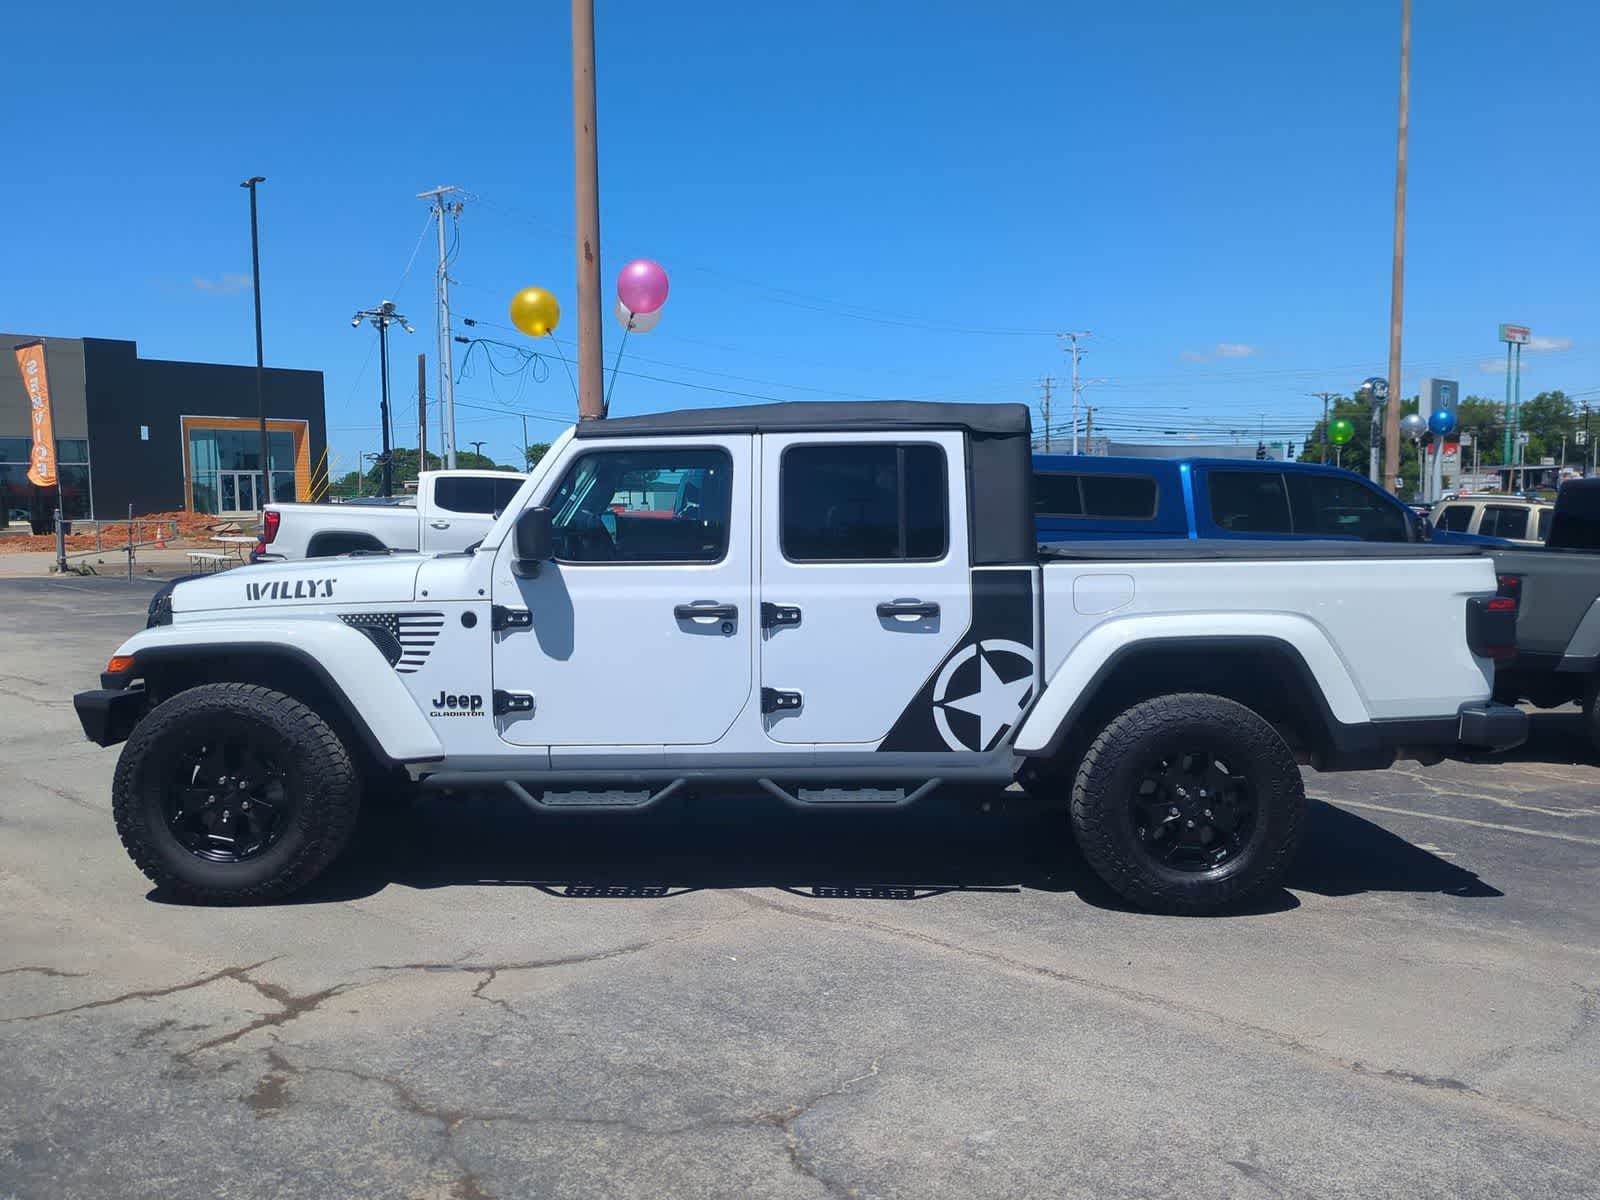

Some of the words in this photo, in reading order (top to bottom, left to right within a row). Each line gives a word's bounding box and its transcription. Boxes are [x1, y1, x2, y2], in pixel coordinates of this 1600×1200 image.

[26, 359, 48, 477] SERVICE
[246, 579, 337, 600] WILLYS
[432, 690, 483, 711] Jeep
